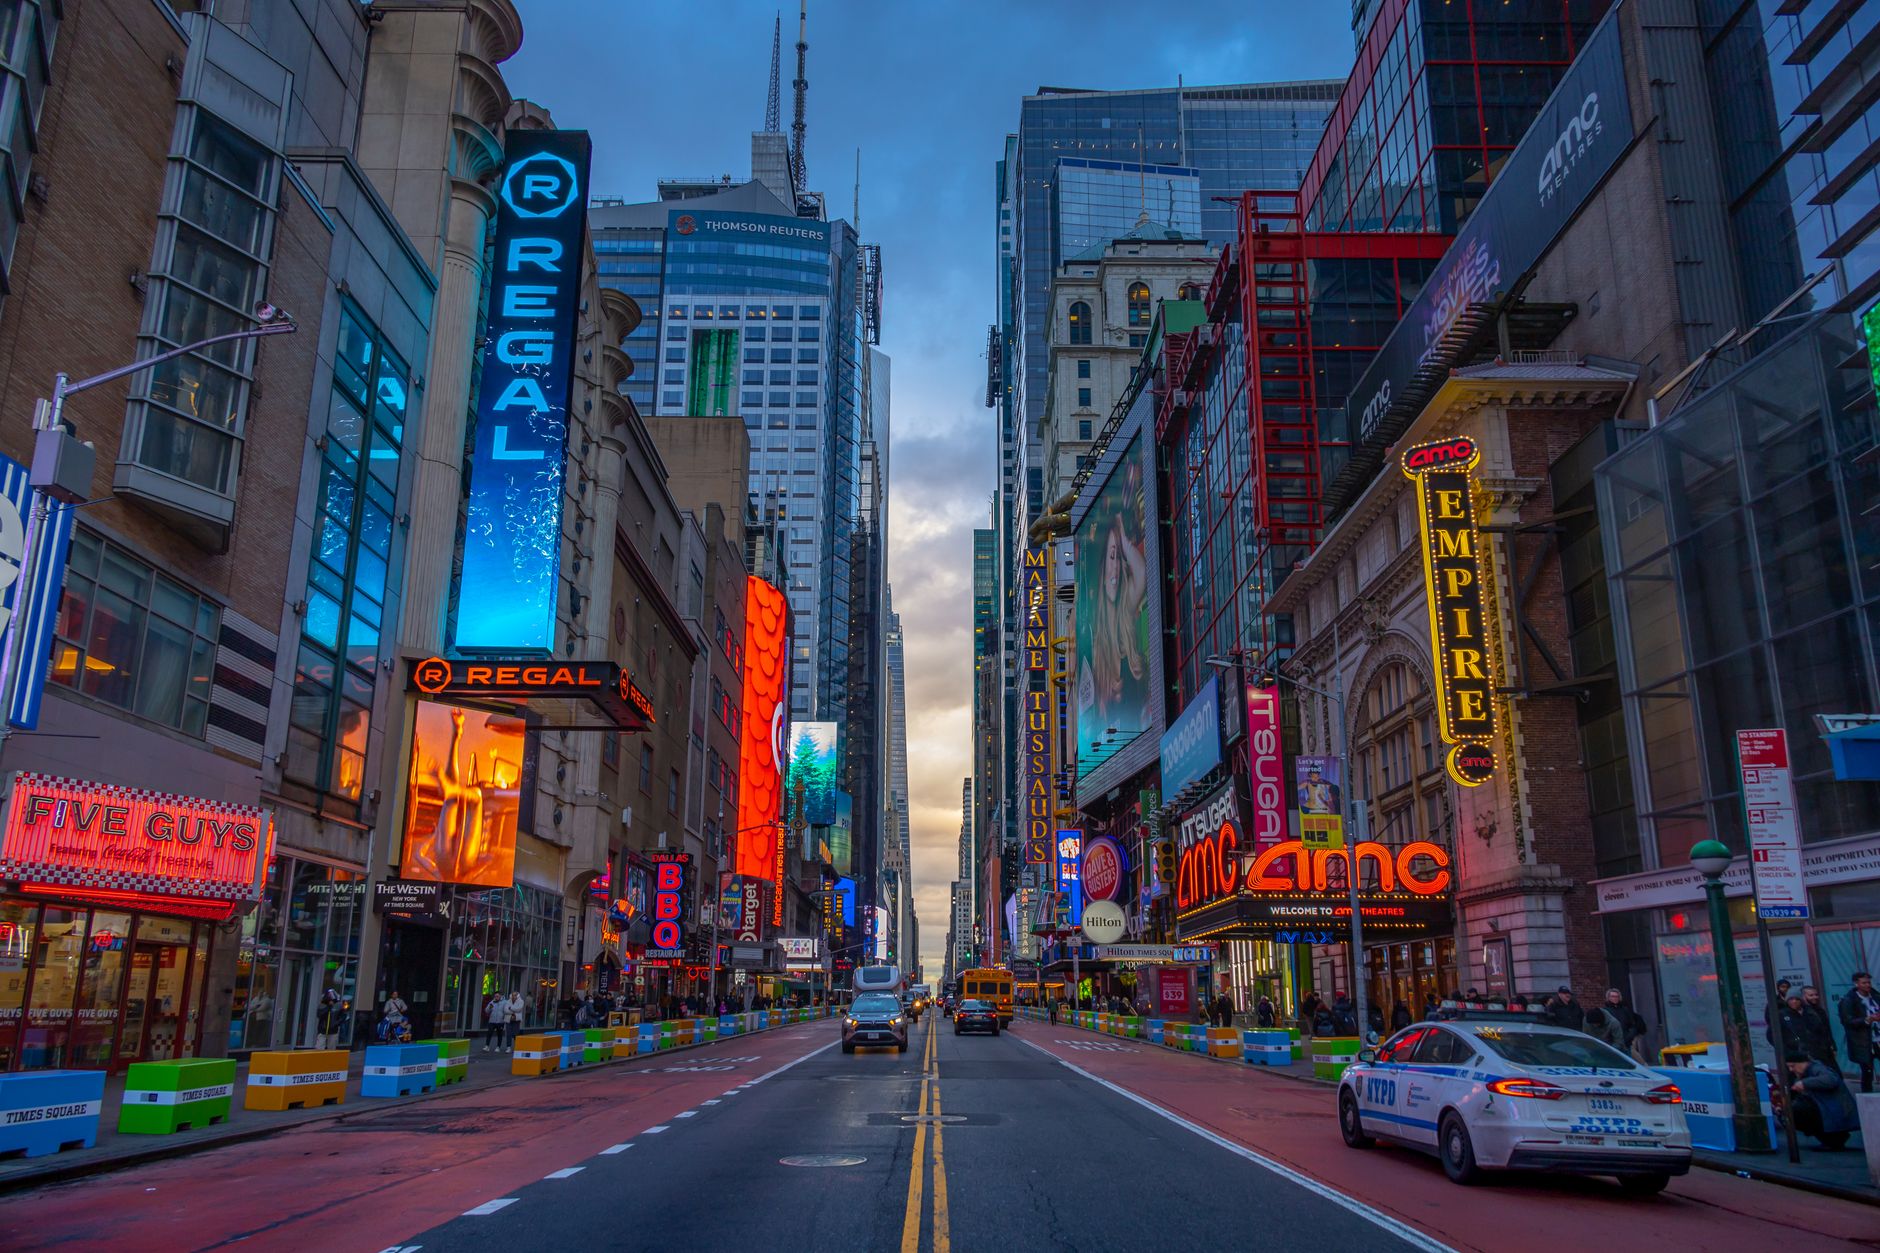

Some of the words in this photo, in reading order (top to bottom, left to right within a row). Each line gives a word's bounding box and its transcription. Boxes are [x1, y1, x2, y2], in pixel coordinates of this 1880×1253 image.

[1539, 93, 1599, 194] amc
[1539, 119, 1602, 208] THEATRES
[705, 220, 766, 233] THOMSON
[769, 225, 824, 241] REUTERS
[1424, 242, 1488, 346] MOVIES
[492, 237, 563, 460] REGAL
[1361, 379, 1390, 435] amc
[1408, 441, 1472, 468] amc
[1025, 550, 1047, 669] MADAME
[1436, 490, 1487, 721] EMPIRE
[466, 667, 601, 685] REGAL
[630, 687, 656, 723] REGAL
[1461, 755, 1492, 767] amc
[1029, 691, 1048, 861] TUSSAUD'S
[25, 795, 128, 836] FIVE
[145, 812, 256, 851] GUYS
[1180, 784, 1240, 848] IT'SUGAR
[652, 854, 689, 863] DALLAS
[1086, 853, 1107, 878] DAVE
[1106, 852, 1114, 867] &
[1178, 820, 1236, 908] amc
[1247, 841, 1450, 894] amc
[1804, 855, 1824, 866] TAIL
[376, 884, 396, 894] THE
[396, 884, 436, 895] WESTIN
[1087, 866, 1116, 894] BUSTER'S
[654, 863, 684, 950] BBQ
[743, 883, 759, 931] target
[1270, 907, 1317, 915] WELCOME
[1320, 907, 1333, 915] TO
[1335, 907, 1353, 916] am
[1761, 908, 1789, 916] 103939
[1086, 917, 1122, 927] Hilton
[1275, 931, 1335, 944] IMAX
[645, 949, 687, 958] RESTAURANT
[1107, 947, 1134, 956] Hilton
[1164, 990, 1183, 1000] $39
[28, 1008, 48, 1018] FIVE
[49, 1008, 73, 1018] GUYS
[78, 1008, 96, 1018] FIVE
[97, 1009, 119, 1018] GUYS
[292, 1075, 314, 1084] TIMES
[315, 1073, 340, 1083] SQUARE
[402, 1066, 416, 1074] TIMES
[417, 1064, 433, 1072] SQUARE
[182, 1090, 202, 1101] TIMES
[203, 1086, 228, 1098] SQUARE
[1367, 1077, 1395, 1106] NYPD
[6, 1108, 43, 1123] TIMES
[46, 1104, 87, 1118] SQUARE
[1591, 1099, 1614, 1109] 3383
[1570, 1125, 1653, 1136] POLICE
[1577, 1116, 1642, 1127] NYPD
